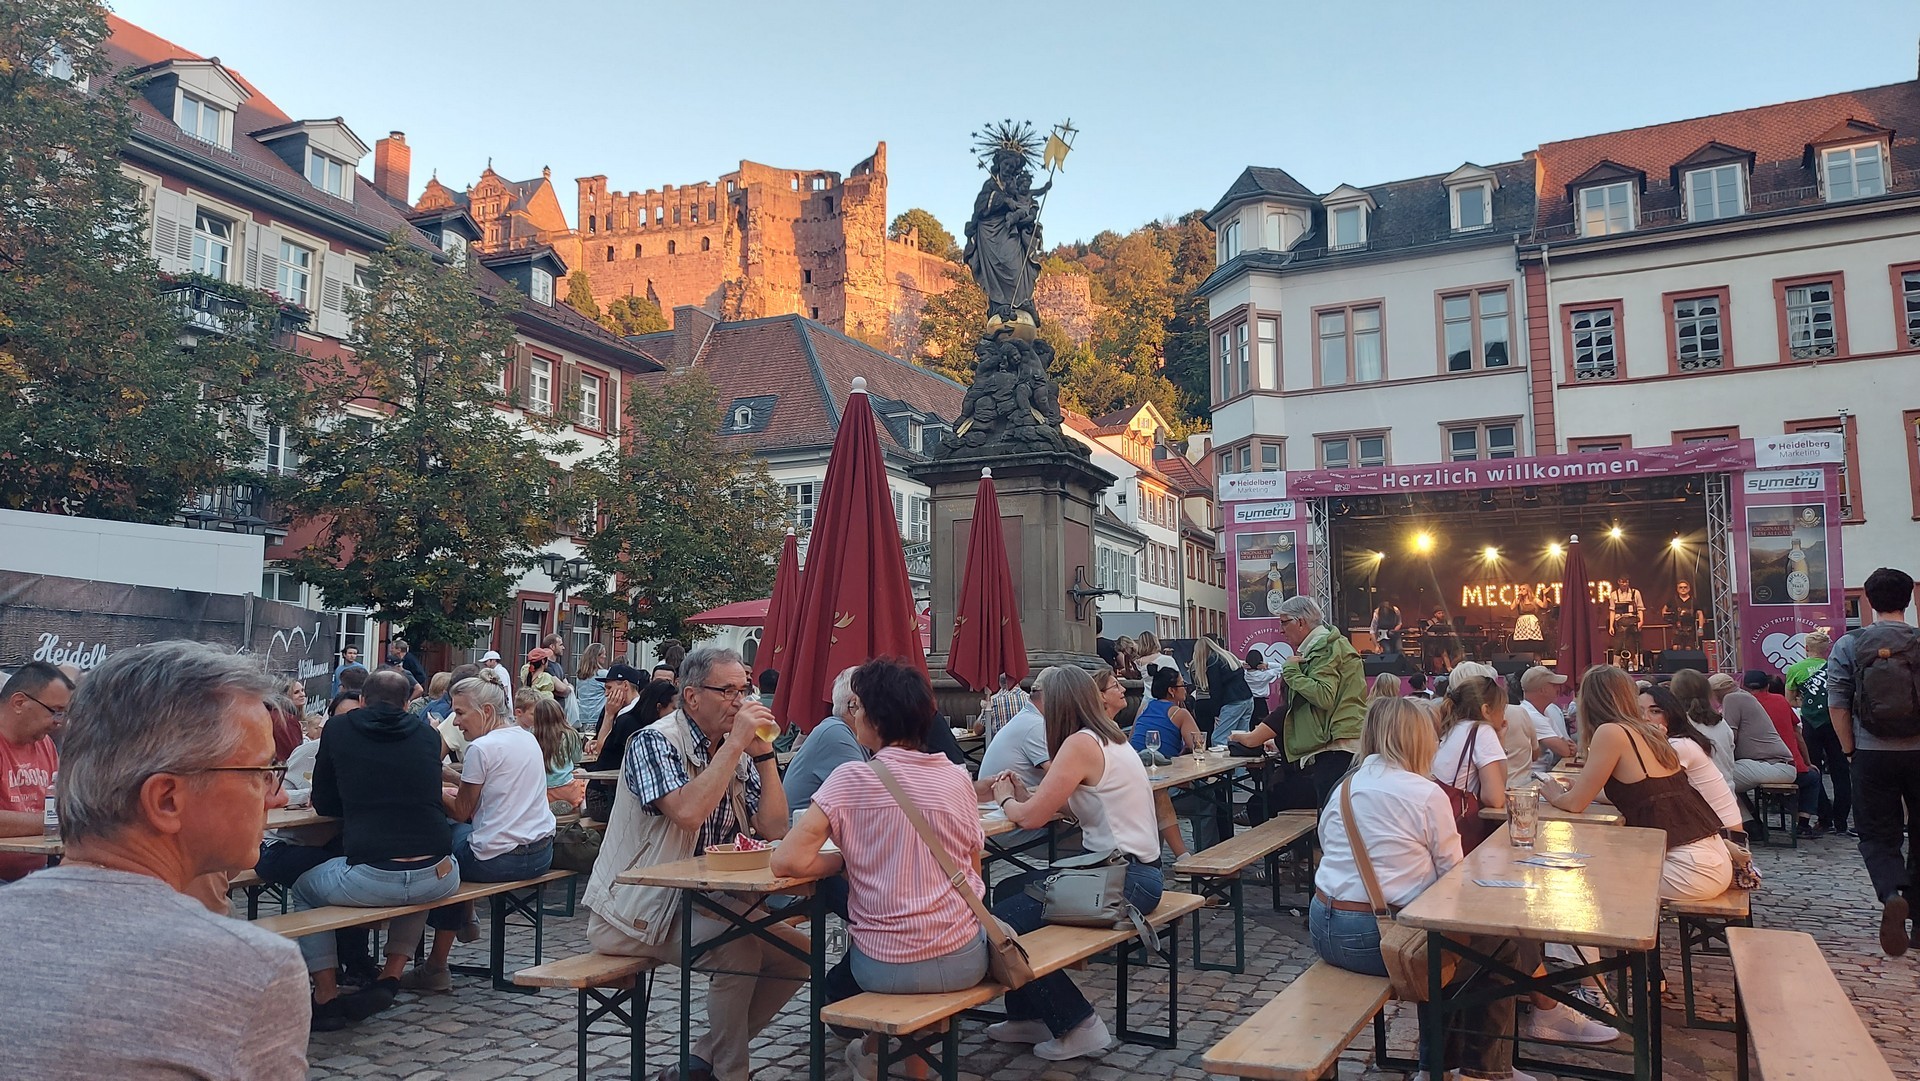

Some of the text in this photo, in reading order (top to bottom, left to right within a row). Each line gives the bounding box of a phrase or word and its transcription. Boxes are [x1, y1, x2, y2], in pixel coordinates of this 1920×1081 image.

[1779, 440, 1830, 450] Heidelberg
[1779, 449, 1820, 458] Marketing
[1382, 458, 1640, 488] Herzlich willkommen
[1237, 479, 1277, 487] Heidelberg
[1747, 475, 1819, 491] symetry
[1237, 506, 1291, 521] symetry
[1254, 628, 1273, 636] TRIFFT
[1751, 622, 1770, 644] ALLGÄU
[1770, 616, 1794, 625] TRIFFT
[33, 632, 107, 669] Heidelb
